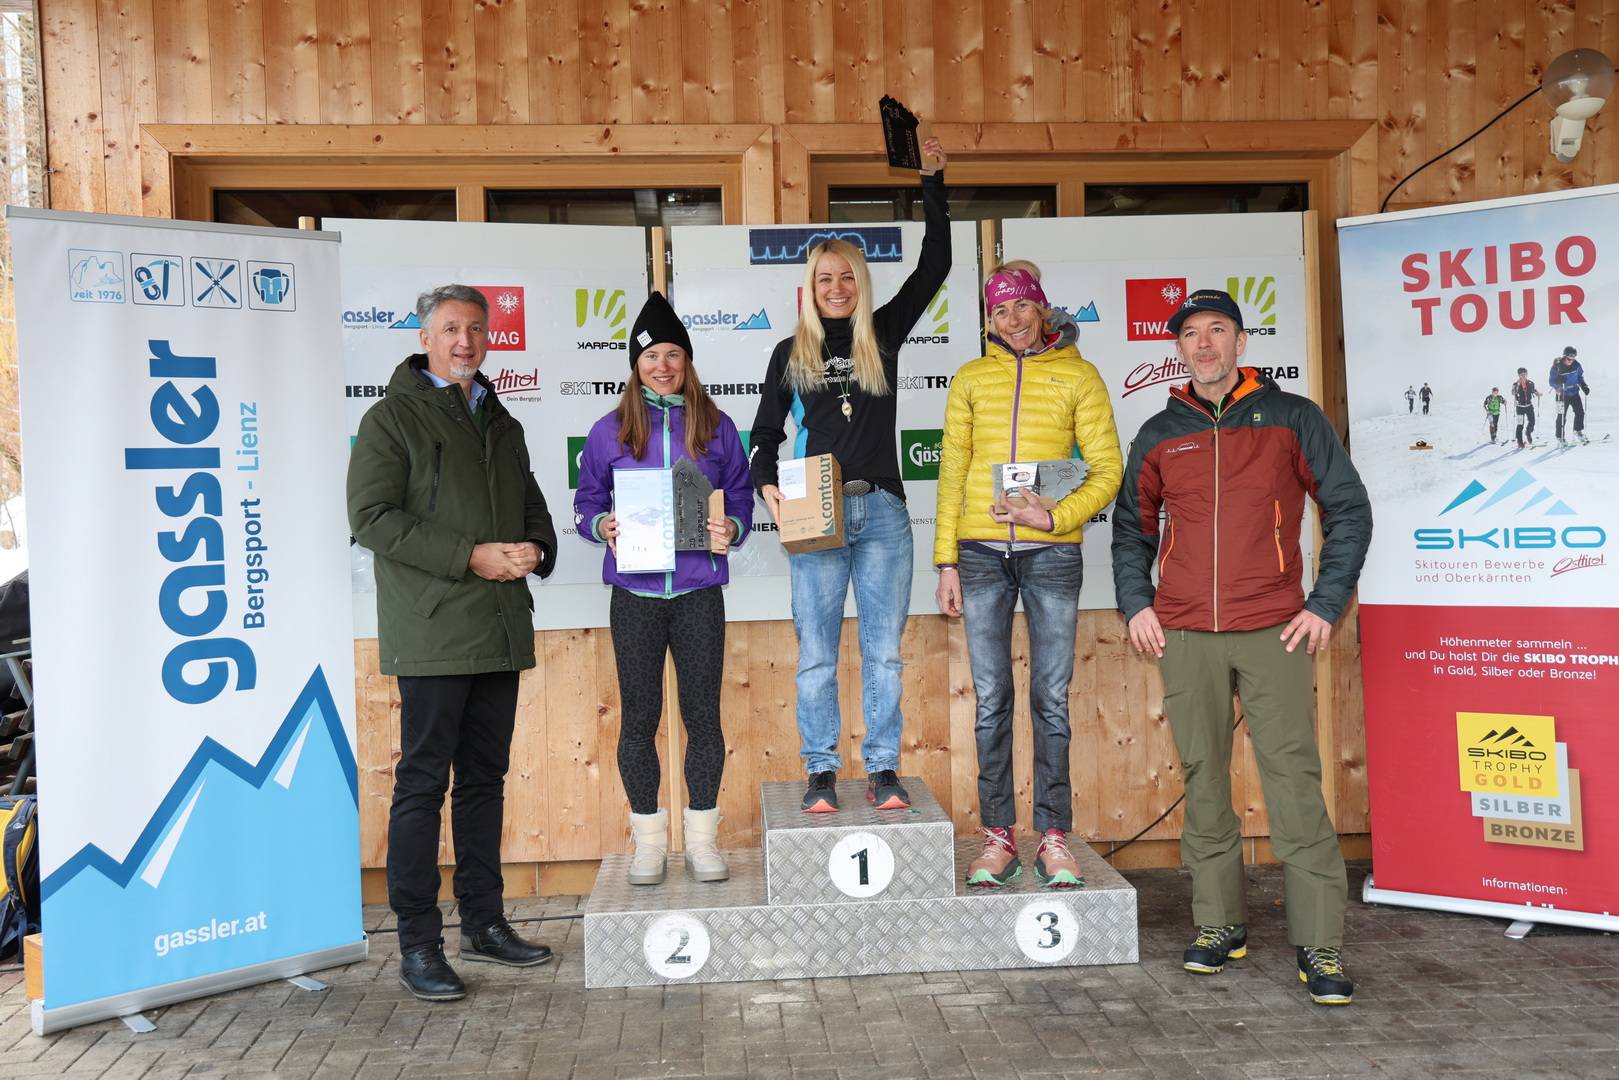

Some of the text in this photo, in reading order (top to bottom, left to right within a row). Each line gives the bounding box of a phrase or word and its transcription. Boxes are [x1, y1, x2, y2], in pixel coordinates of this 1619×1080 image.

[1401, 235, 1597, 293] SKIBO
[74, 289, 122, 300] seit 1976
[341, 306, 395, 325] assler
[682, 310, 738, 330] gassler
[1411, 285, 1588, 336] TOUR
[577, 341, 627, 350] KARPOS
[1257, 366, 1299, 379] RAB
[897, 375, 955, 390] SKITR
[236, 401, 260, 471] Lienz
[909, 442, 943, 467] Gös
[818, 456, 834, 519] contour
[124, 339, 257, 705] gassler
[1413, 526, 1607, 550] SKIBO
[240, 498, 269, 629] Bergsport
[1415, 560, 1545, 570] Skitouren Bewerbe
[1415, 573, 1532, 583] und Oberkärnten
[1439, 636, 1512, 648] Höhenmeter
[1516, 639, 1572, 649] sammeln
[1405, 651, 1426, 660] und
[1430, 651, 1445, 660] Du
[1449, 651, 1477, 662] holst
[1481, 653, 1498, 663] Dir
[1502, 653, 1520, 663] die
[1523, 654, 1566, 664] SKIBO
[1447, 666, 1477, 677] Gold,
[1481, 667, 1513, 677] Silber
[1518, 668, 1545, 678] oder
[1550, 669, 1597, 680] Bronze!
[1467, 747, 1547, 761] SKIBO
[1472, 760, 1543, 774] TROPHY
[1475, 773, 1543, 790] GOLD
[1479, 798, 1562, 817] SILBER
[1490, 823, 1576, 844] BRONZE
[850, 847, 869, 886] 1
[1482, 877, 1568, 895] Informationen:
[154, 911, 268, 957] gassler.at
[1035, 911, 1062, 950] 3
[664, 927, 693, 965] 2
